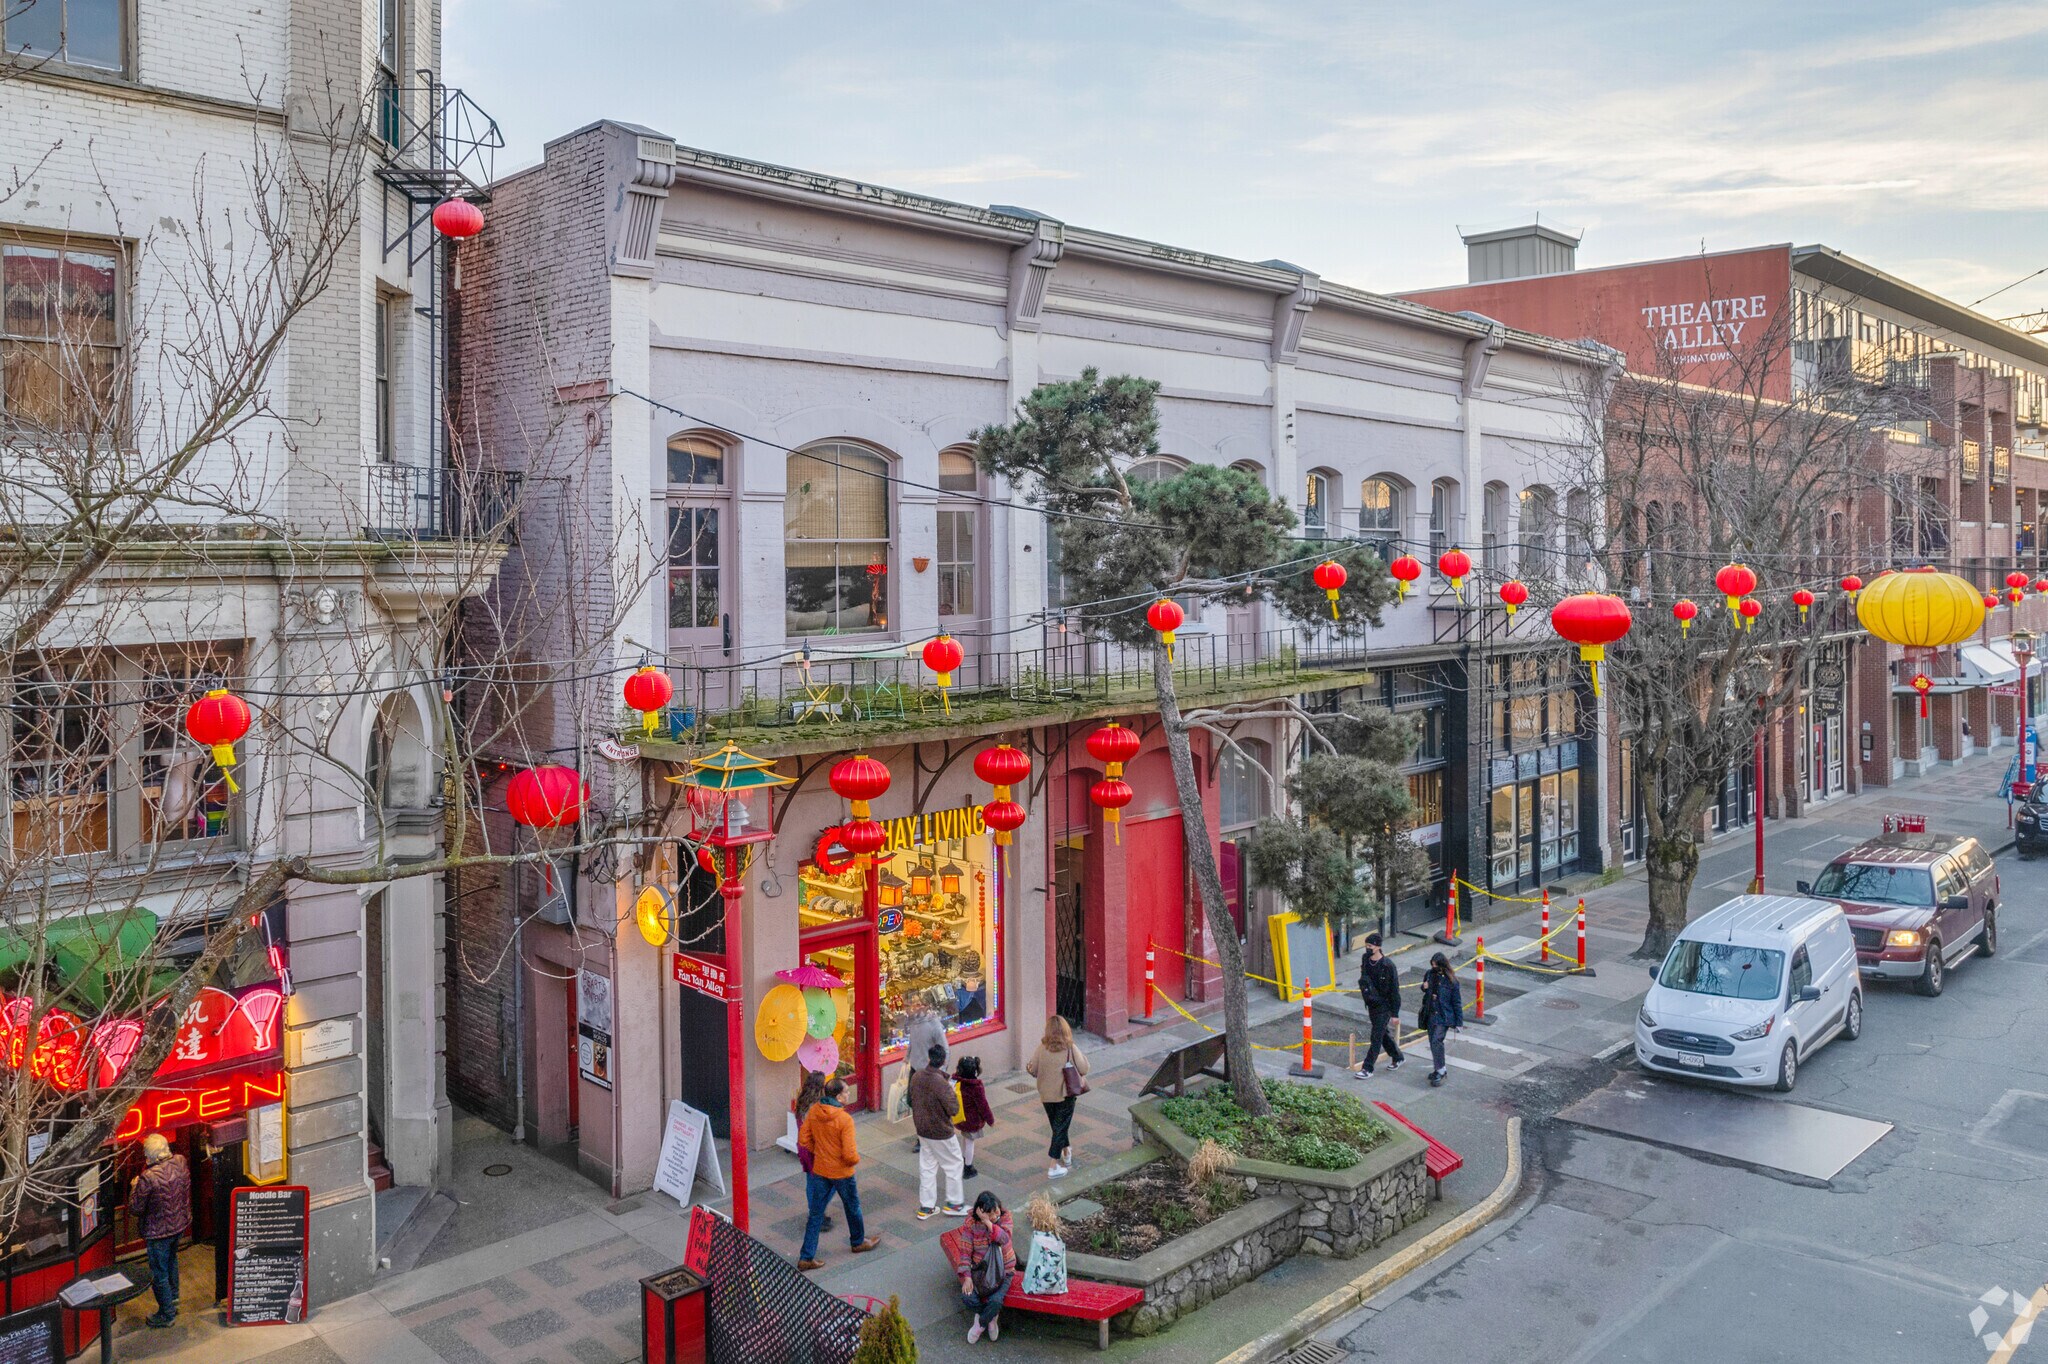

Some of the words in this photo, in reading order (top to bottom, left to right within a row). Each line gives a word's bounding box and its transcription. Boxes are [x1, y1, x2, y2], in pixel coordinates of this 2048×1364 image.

[1642, 295, 1766, 328] THEATRE
[1664, 321, 1745, 350] ALLEY
[605, 743, 637, 757] ENTRANCE
[924, 804, 986, 846] LIVING
[678, 968, 691, 983] Fan
[691, 974, 704, 988] Tan
[704, 979, 724, 997] Alley
[249, 1191, 277, 1200] Noodle
[277, 1190, 292, 1199] Bar
